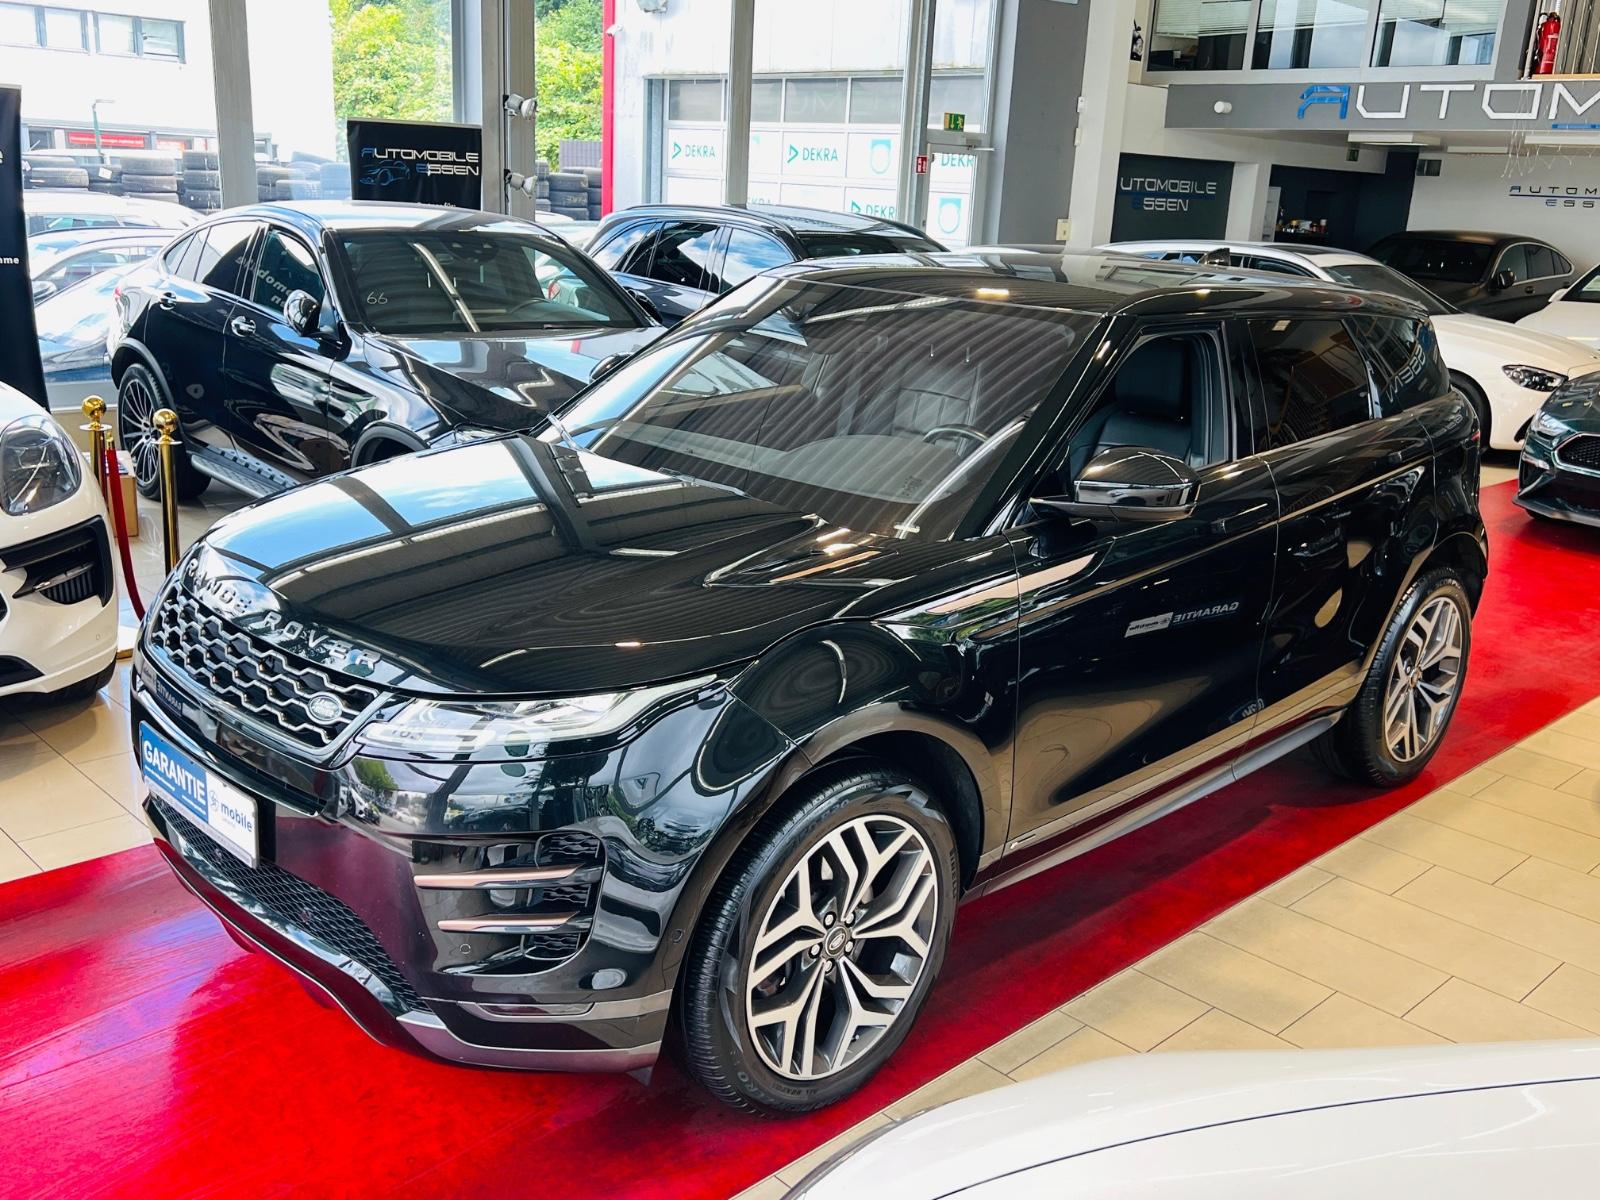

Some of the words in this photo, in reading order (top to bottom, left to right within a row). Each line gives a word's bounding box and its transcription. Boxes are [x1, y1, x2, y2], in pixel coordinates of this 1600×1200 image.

[361, 147, 479, 163] AUTOMOBILE
[685, 144, 716, 158] DEKRA
[802, 147, 839, 161] DEKRA
[941, 153, 975, 167] DEKR
[415, 162, 479, 176] ESSEN
[1120, 177, 1217, 194] UTOMOBILE
[865, 204, 898, 219] DEKR
[183, 557, 254, 615] RANGE
[260, 610, 382, 671] ROVER
[143, 740, 207, 806] GARANTIE
[220, 802, 253, 833] mobile
